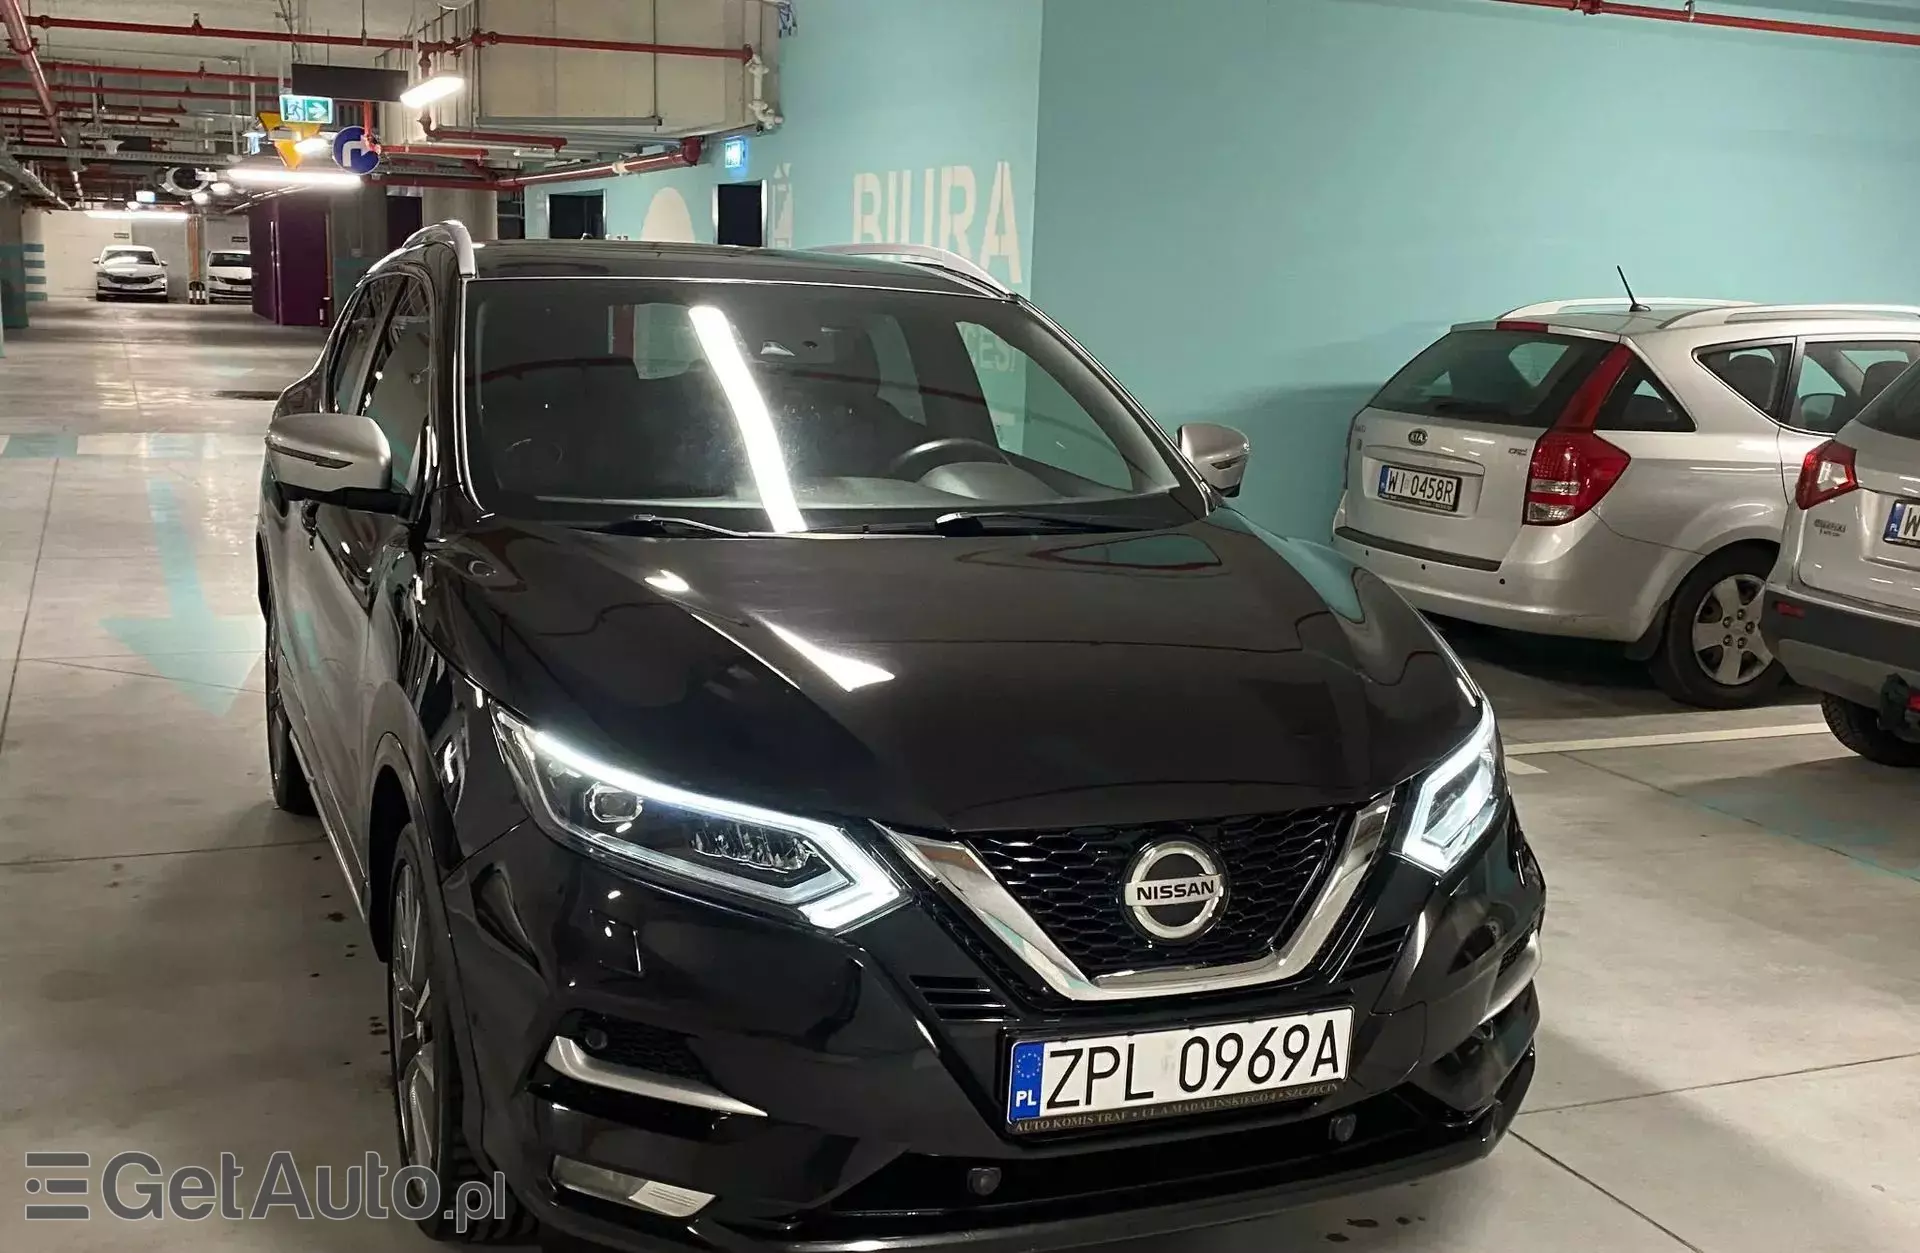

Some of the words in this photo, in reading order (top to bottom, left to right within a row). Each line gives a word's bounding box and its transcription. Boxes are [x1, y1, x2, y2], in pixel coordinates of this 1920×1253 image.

[853, 161, 1022, 284] BIURA
[1388, 470, 1405, 494] WI
[1410, 474, 1454, 503] 0458R
[1137, 880, 1214, 901] NISSAN
[1046, 1043, 1154, 1109] ZPL
[1178, 1019, 1339, 1093] 0969A
[1015, 1089, 1037, 1107] PL
[1016, 1119, 1050, 1132] AUTO
[1052, 1115, 1093, 1130] KOMIS
[1285, 1082, 1338, 1099] SZCZECIN
